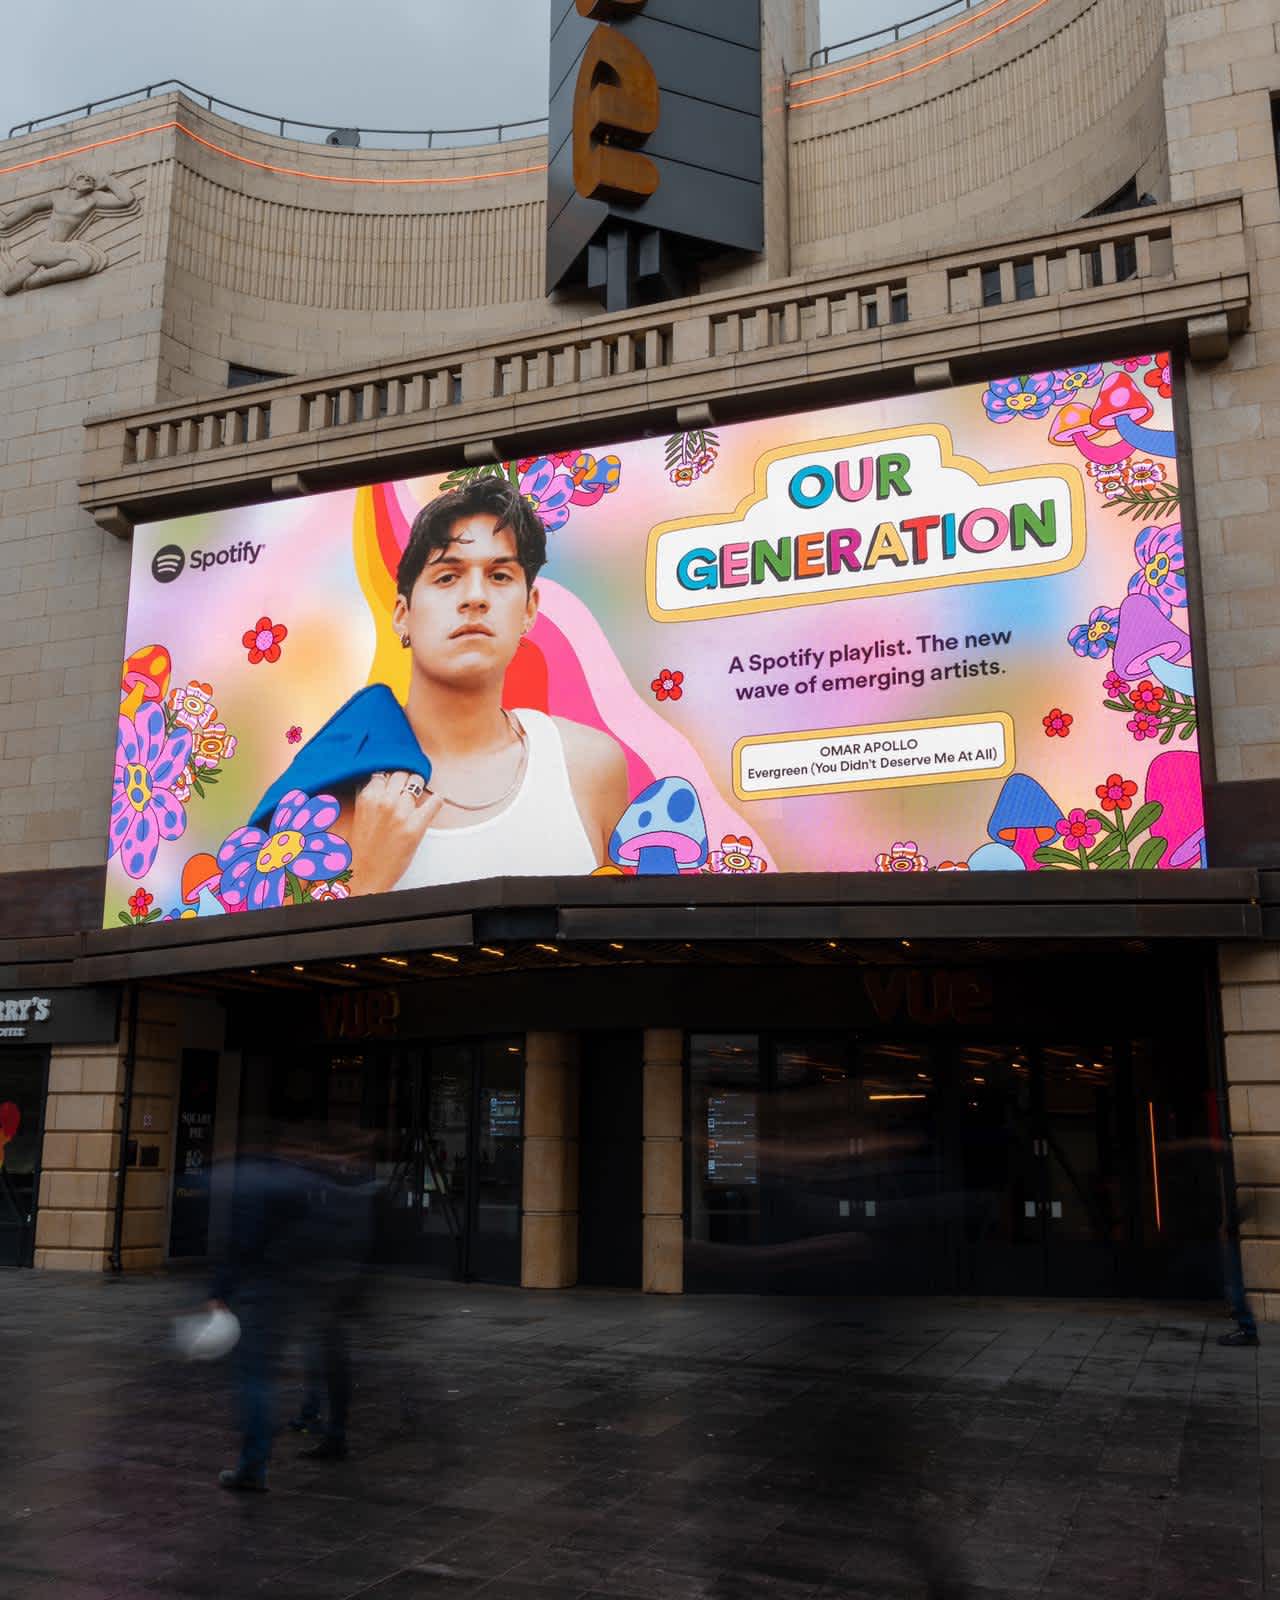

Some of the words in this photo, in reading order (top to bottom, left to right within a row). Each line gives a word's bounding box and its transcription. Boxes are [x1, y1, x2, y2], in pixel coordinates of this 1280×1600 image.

[572, 0, 660, 200] e
[788, 452, 912, 509] OUR
[189, 541, 262, 571] Spotify
[676, 499, 1058, 592] GENERATION
[728, 656, 745, 674] A
[749, 648, 824, 675] Spotify
[829, 640, 912, 667] playlist.
[916, 635, 959, 654] The
[964, 630, 1012, 650] new
[735, 680, 789, 701] wave
[795, 676, 817, 695] of
[822, 667, 925, 691] emerging
[930, 659, 1006, 681] artists.
[747, 765, 808, 780] Evergreen
[810, 761, 837, 776] (You
[840, 757, 876, 772] Didn't
[880, 754, 931, 769] Deserve
[934, 752, 955, 765] Me
[958, 750, 973, 762] At
[975, 747, 998, 762] All)
[820, 743, 861, 757] OMAR
[863, 738, 918, 754] APOLLO
